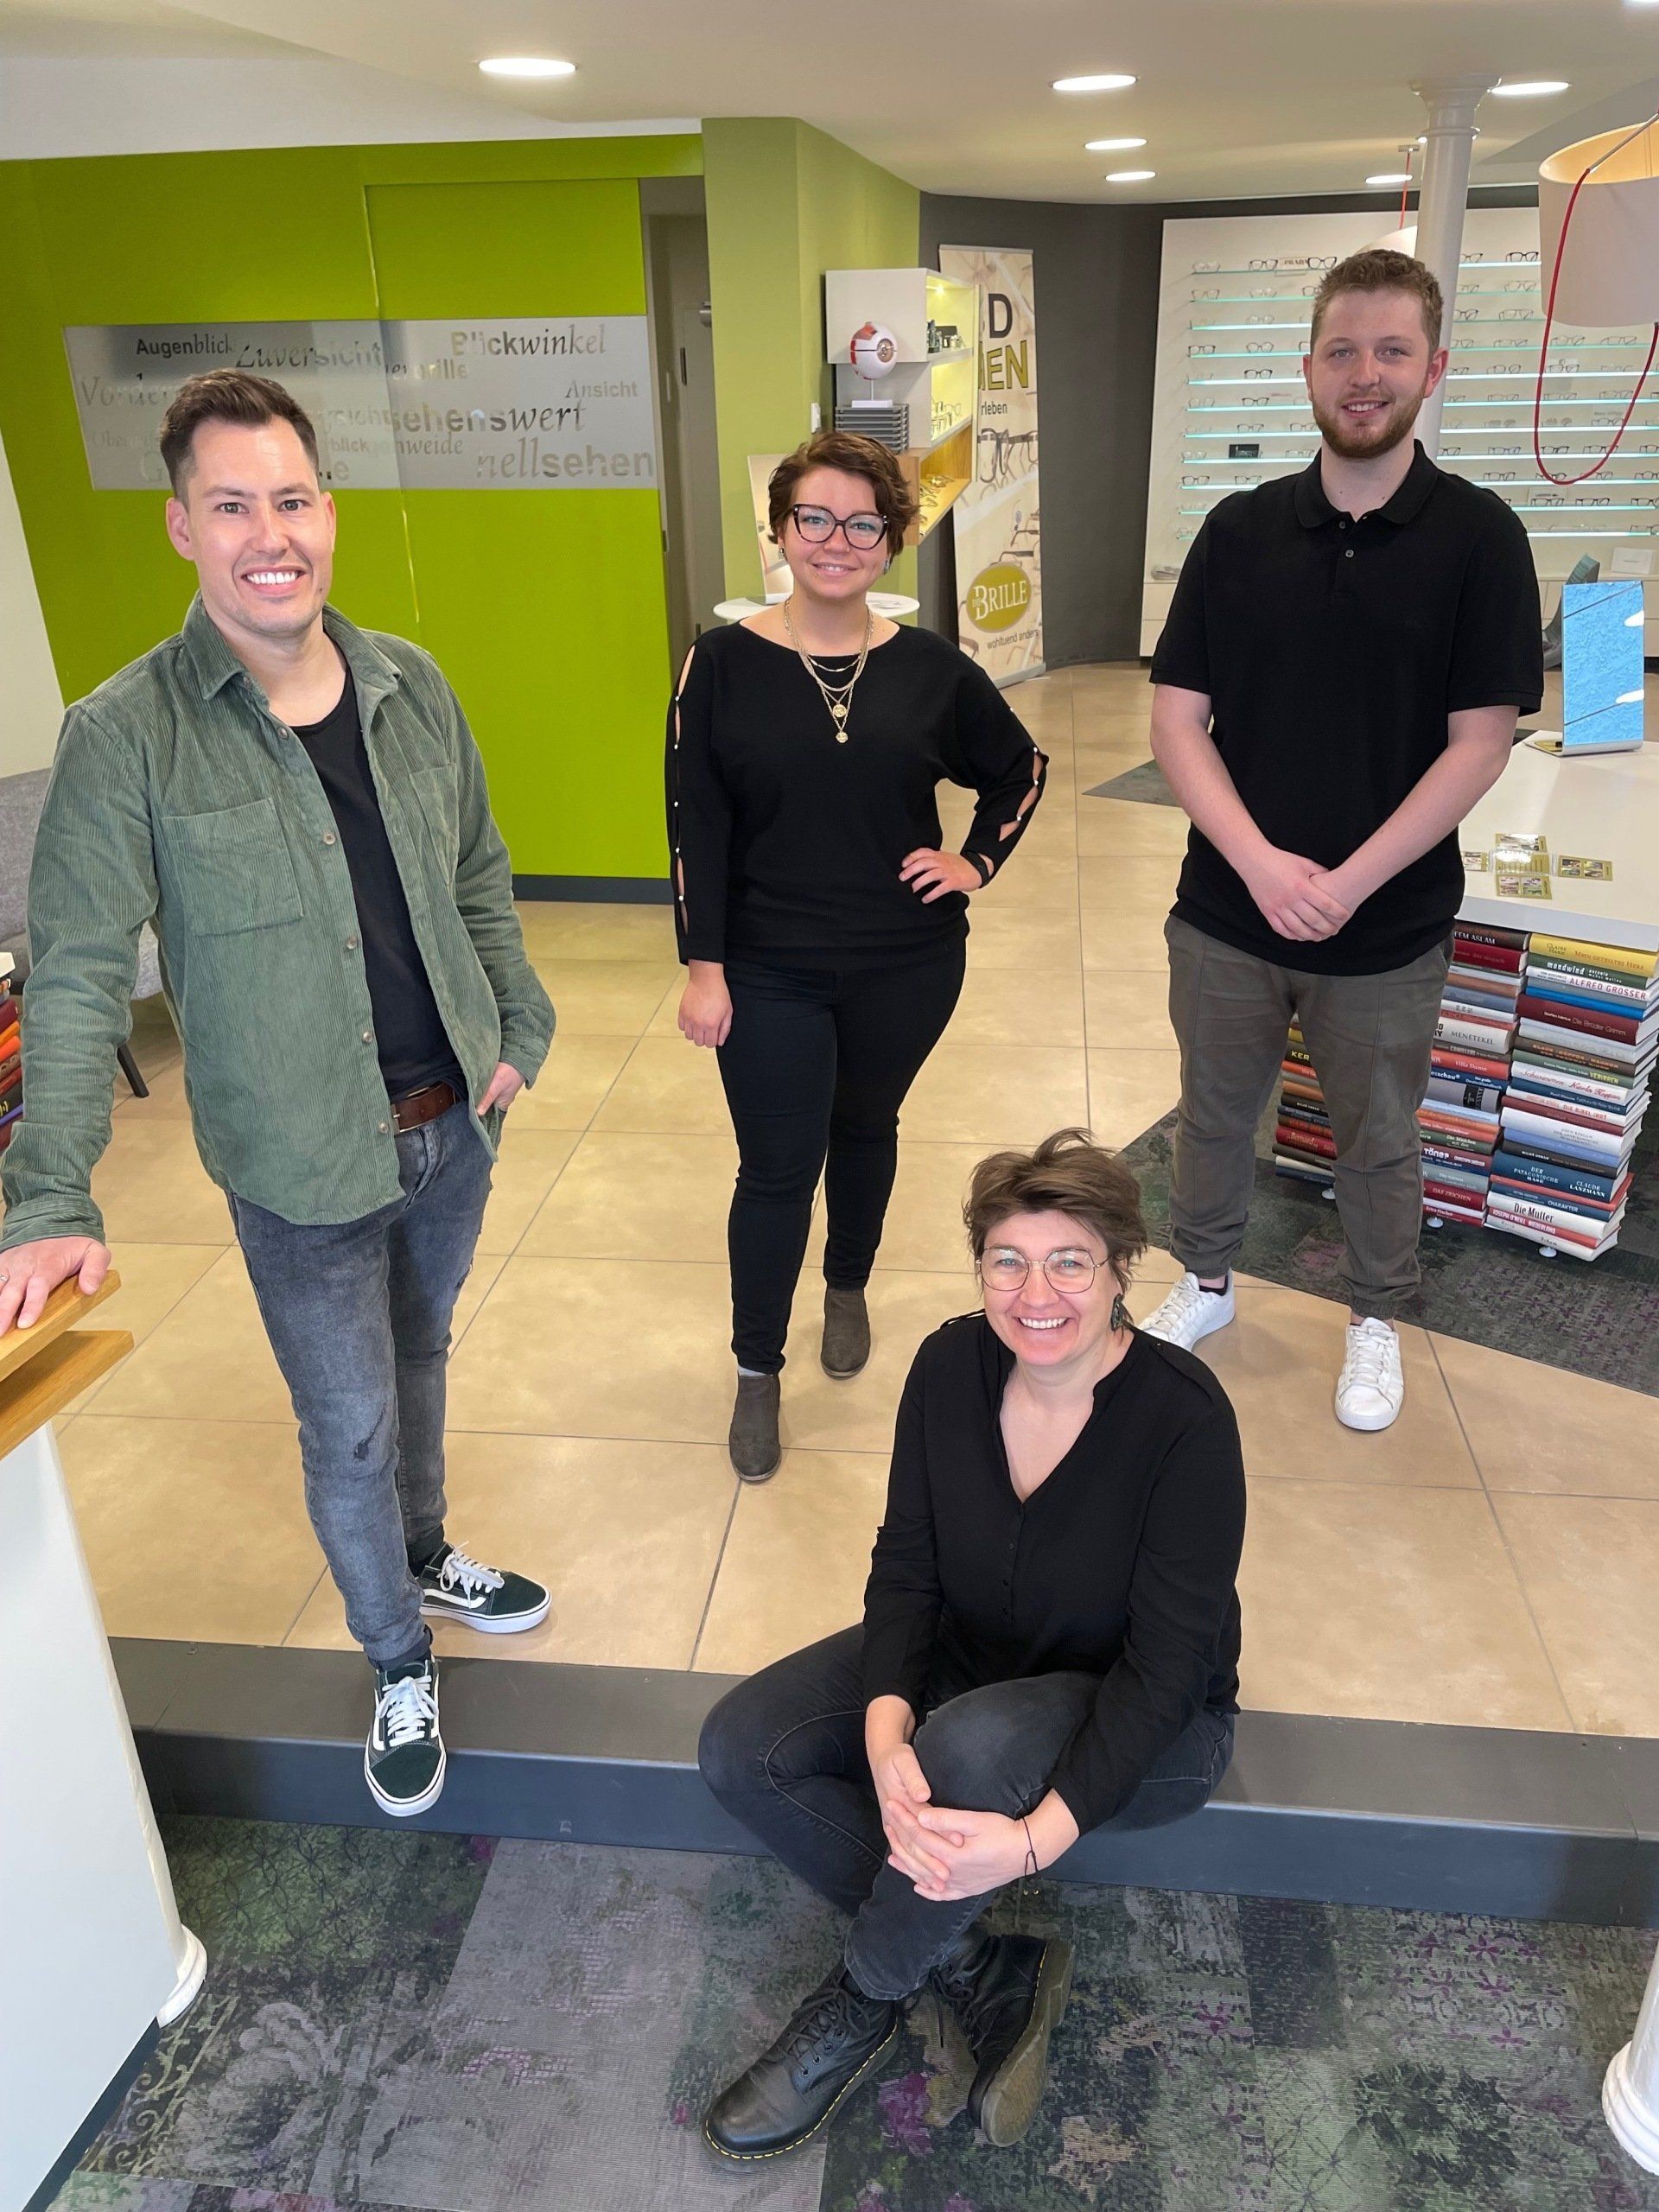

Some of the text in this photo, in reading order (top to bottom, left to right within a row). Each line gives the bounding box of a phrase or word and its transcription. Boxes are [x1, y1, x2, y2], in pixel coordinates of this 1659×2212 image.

[981, 401, 1007, 416] rleben
[1569, 977, 1646, 1000] ALFRED GROSSER
[1452, 1031, 1494, 1045] MENETEKEL
[1569, 1185, 1605, 1198] LANZMANN
[1576, 1180, 1600, 1191] CLAUDE
[1514, 1203, 1554, 1224] Die Mutter
